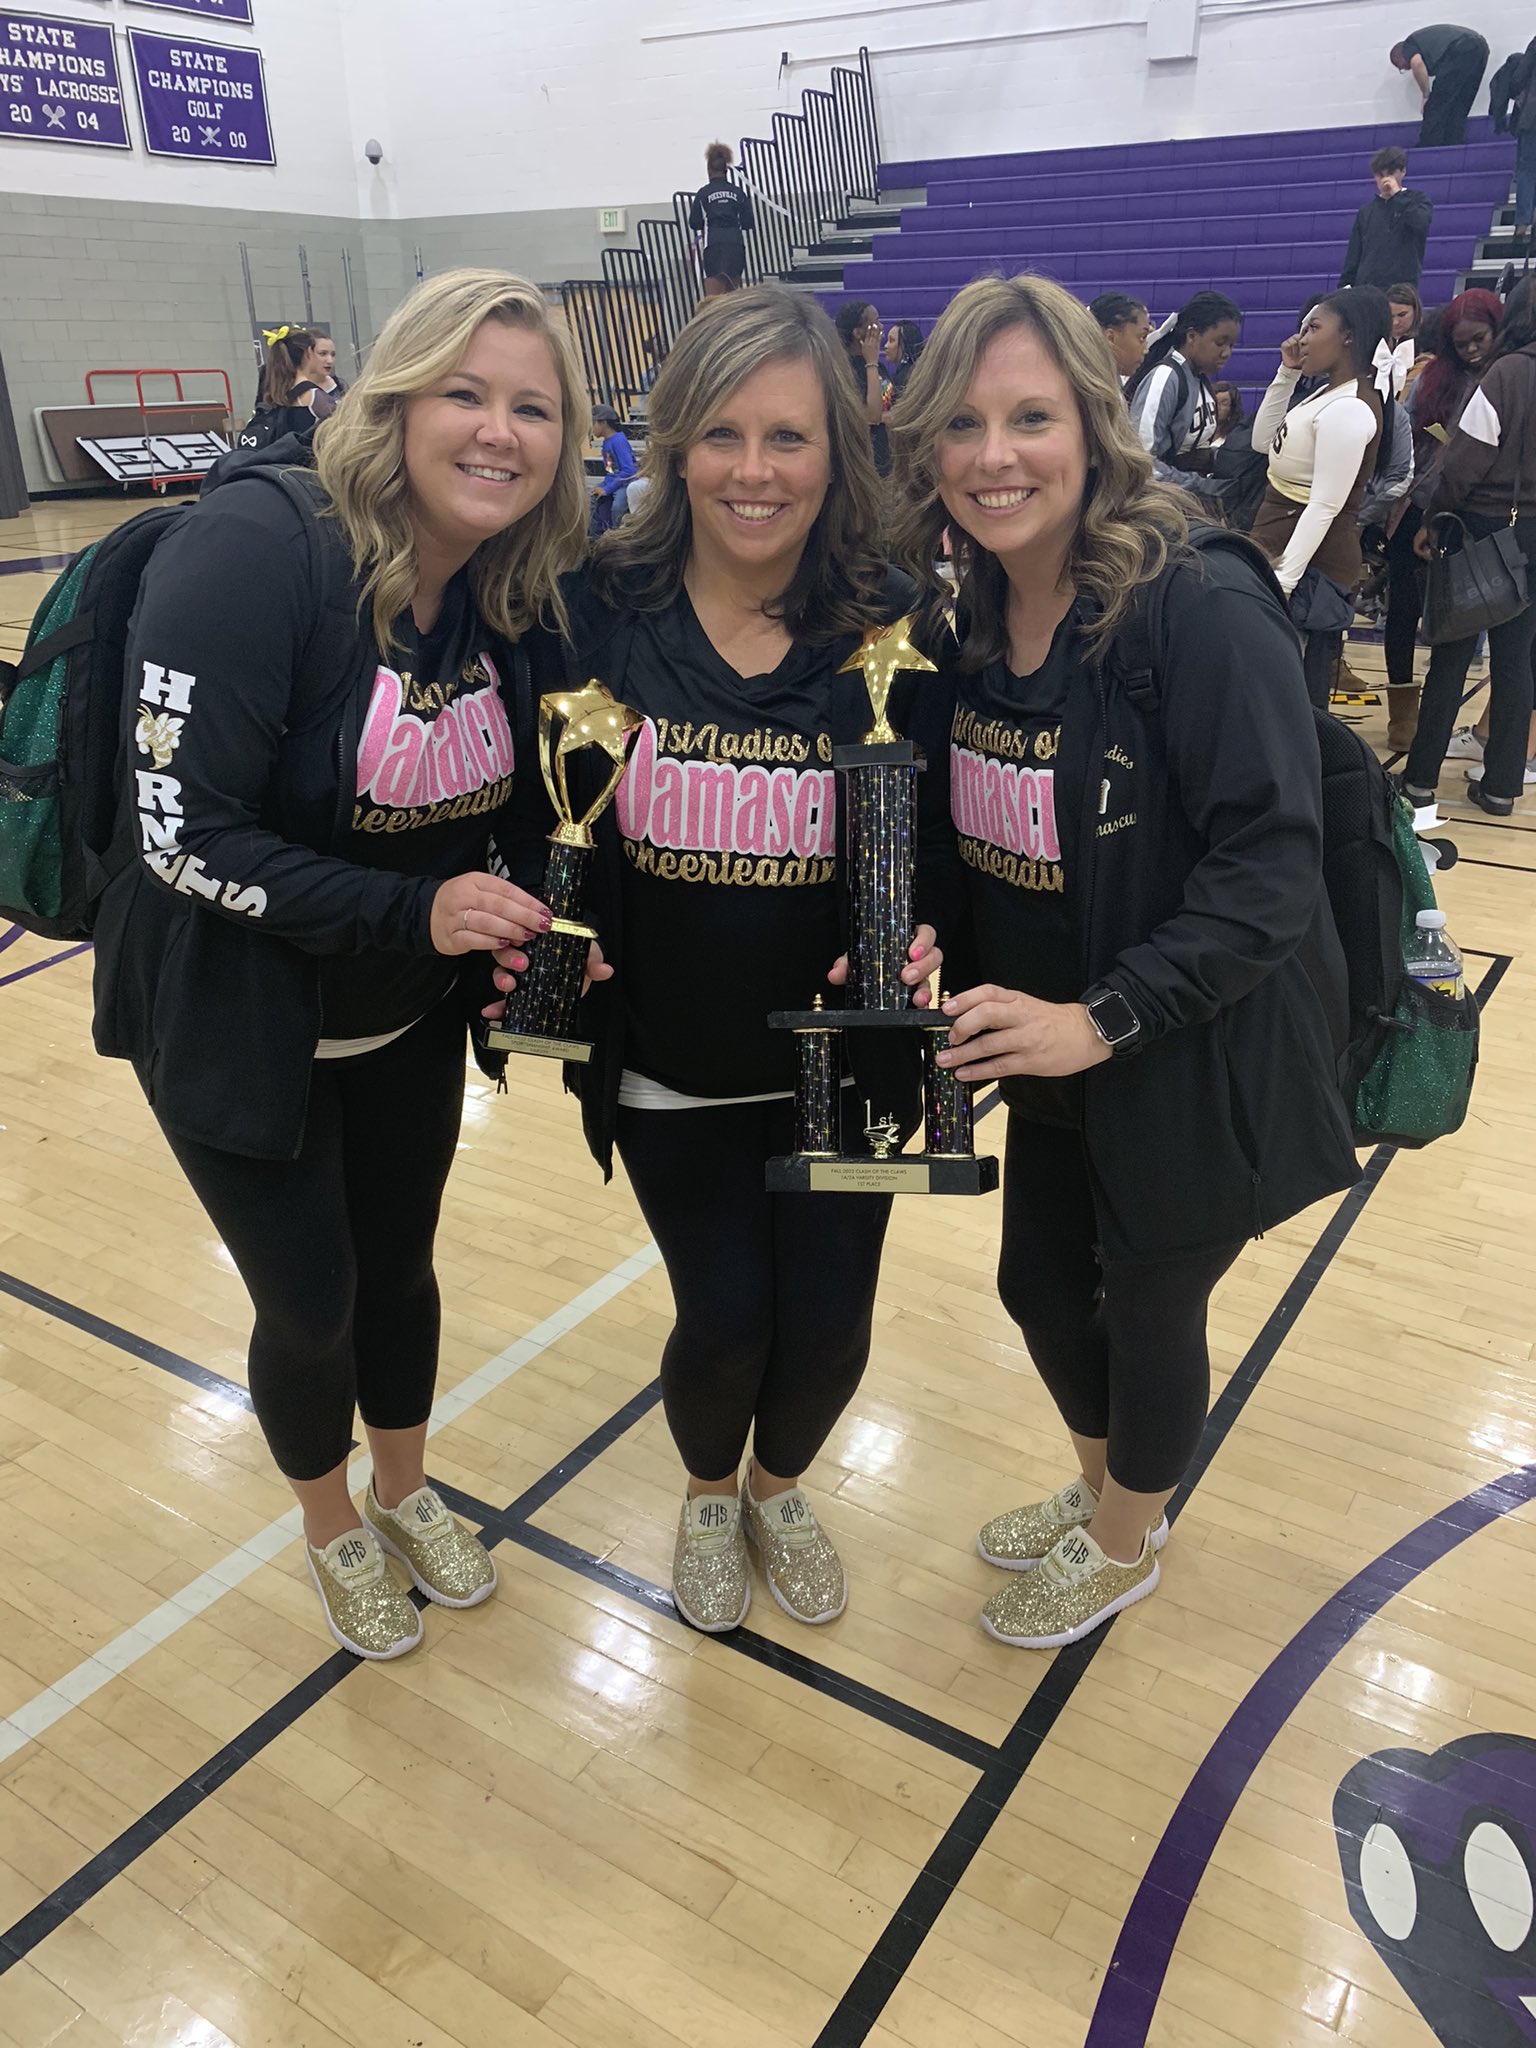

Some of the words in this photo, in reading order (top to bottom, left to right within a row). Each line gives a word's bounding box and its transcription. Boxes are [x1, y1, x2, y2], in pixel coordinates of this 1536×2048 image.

[8, 22, 76, 49] STATE
[0, 47, 106, 77] HAMPIONS
[170, 49, 228, 74] STATE
[0, 73, 24, 93] YS'
[36, 77, 120, 105] LACROSSE
[148, 70, 253, 100] CHAMPIONS
[9, 103, 32, 123] 20
[76, 111, 99, 131] 04
[187, 100, 223, 120] GOLF
[171, 125, 191, 143] 20
[229, 131, 247, 148] 00
[604, 212, 618, 227] EXIT
[356, 655, 515, 808] Daascu
[657, 718, 694, 754] 1st
[694, 722, 811, 763] Ladies
[817, 732, 833, 763] o
[1104, 744, 1134, 769] dies
[623, 839, 836, 887] Cheerleadin
[864, 1099, 894, 1127] 1st
[699, 1503, 728, 1527] DHS
[780, 1497, 805, 1524] DHS
[338, 1539, 367, 1568] DHS
